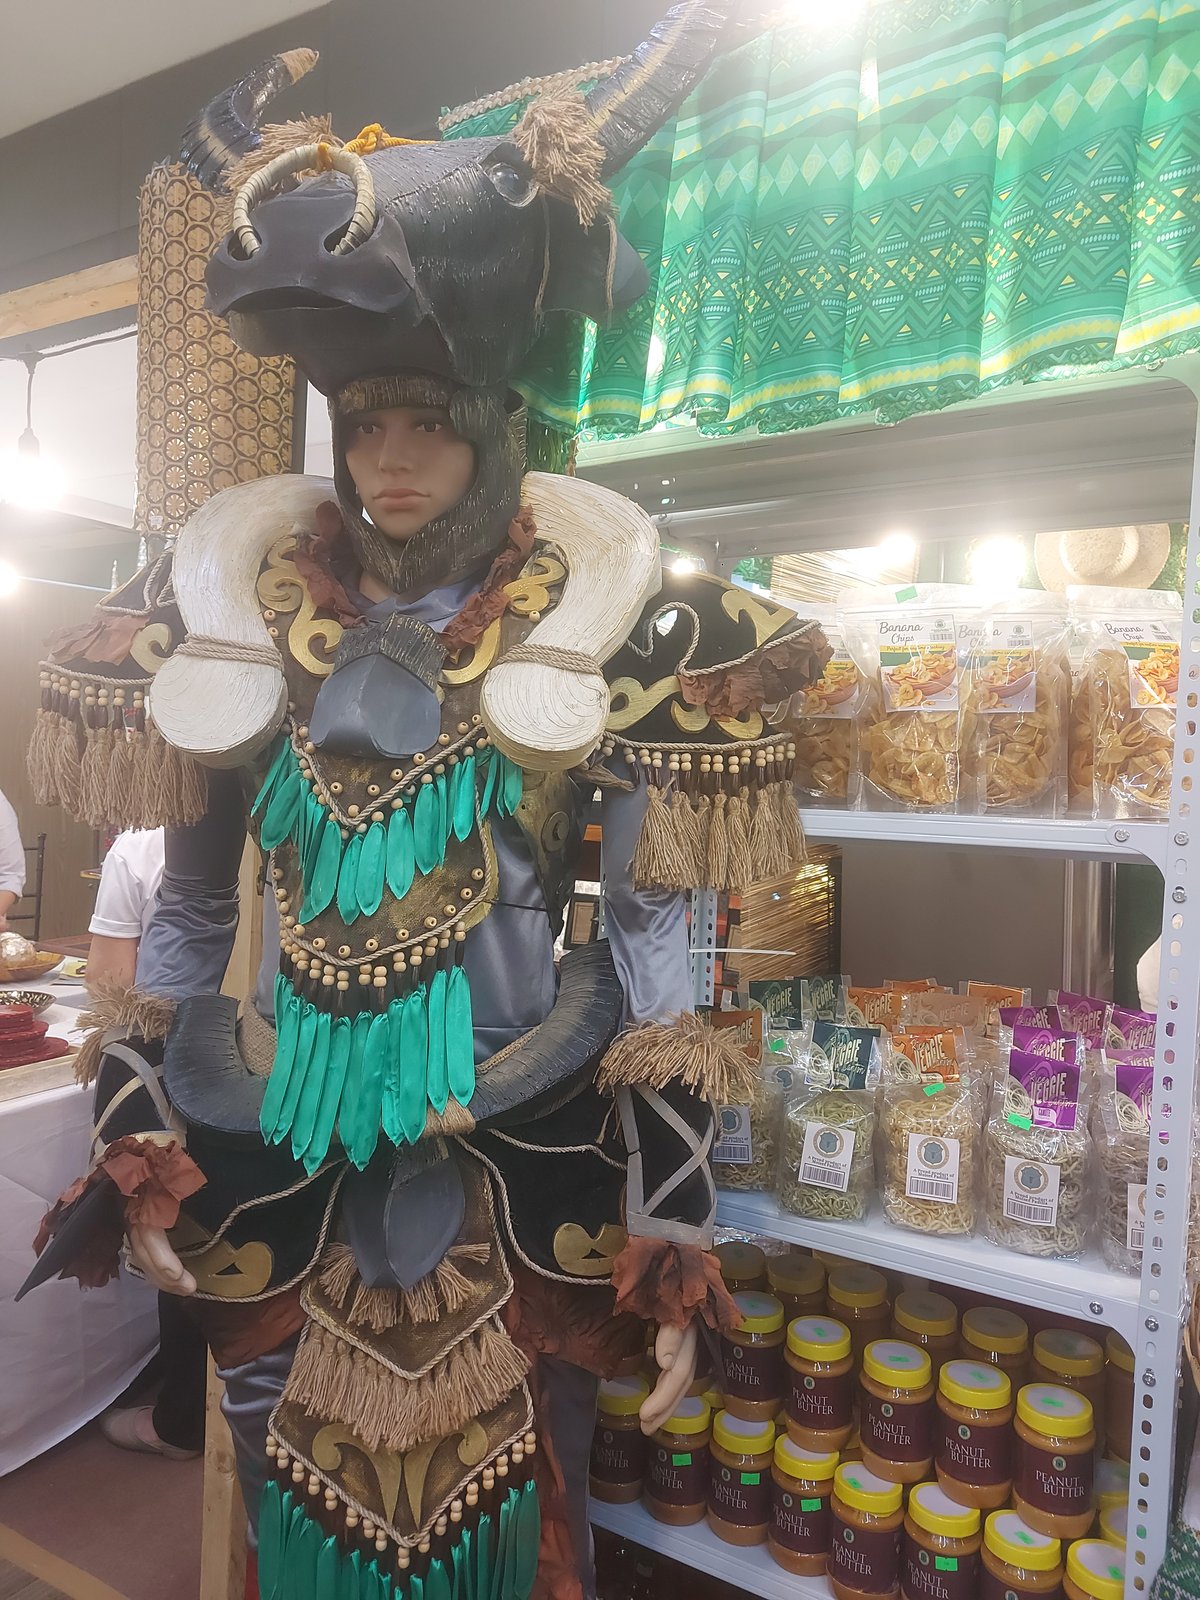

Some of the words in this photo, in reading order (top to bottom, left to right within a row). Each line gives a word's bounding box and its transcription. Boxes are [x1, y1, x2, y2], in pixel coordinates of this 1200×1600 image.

[880, 622, 924, 634] Banana
[959, 624, 1003, 638] Bana
[1104, 623, 1144, 634] Banana
[891, 633, 914, 646] Chips
[766, 986, 793, 1018] VEGGIE
[811, 980, 836, 1010] VEGGIE
[864, 992, 892, 1023] VEGGIE
[1072, 1010, 1102, 1033] VEGGIE
[1128, 1023, 1156, 1050] VEGGI
[830, 1039, 862, 1071] VEGGIE
[914, 1034, 943, 1072] VEGGIE
[1031, 1072, 1067, 1104] VEGGIE
[727, 1368, 760, 1385] BUTTER
[793, 1387, 828, 1406] PEANUT
[797, 1401, 833, 1415] BUTTER
[868, 1414, 906, 1435] PEANUT
[872, 1427, 911, 1445] BUTTER
[945, 1438, 985, 1458] PEANUT
[951, 1450, 991, 1468] BUTTER
[1035, 1470, 1080, 1487] PEANUT
[715, 1488, 747, 1510] BUTTER
[1043, 1483, 1085, 1497] BUTTER
[773, 1504, 805, 1526] PEANUT
[777, 1515, 811, 1537] BUTTER
[832, 1538, 866, 1564] PEANUT
[836, 1554, 872, 1576] BUTTER
[907, 1560, 943, 1586] PEANUT
[911, 1575, 949, 1599] BUTTER
